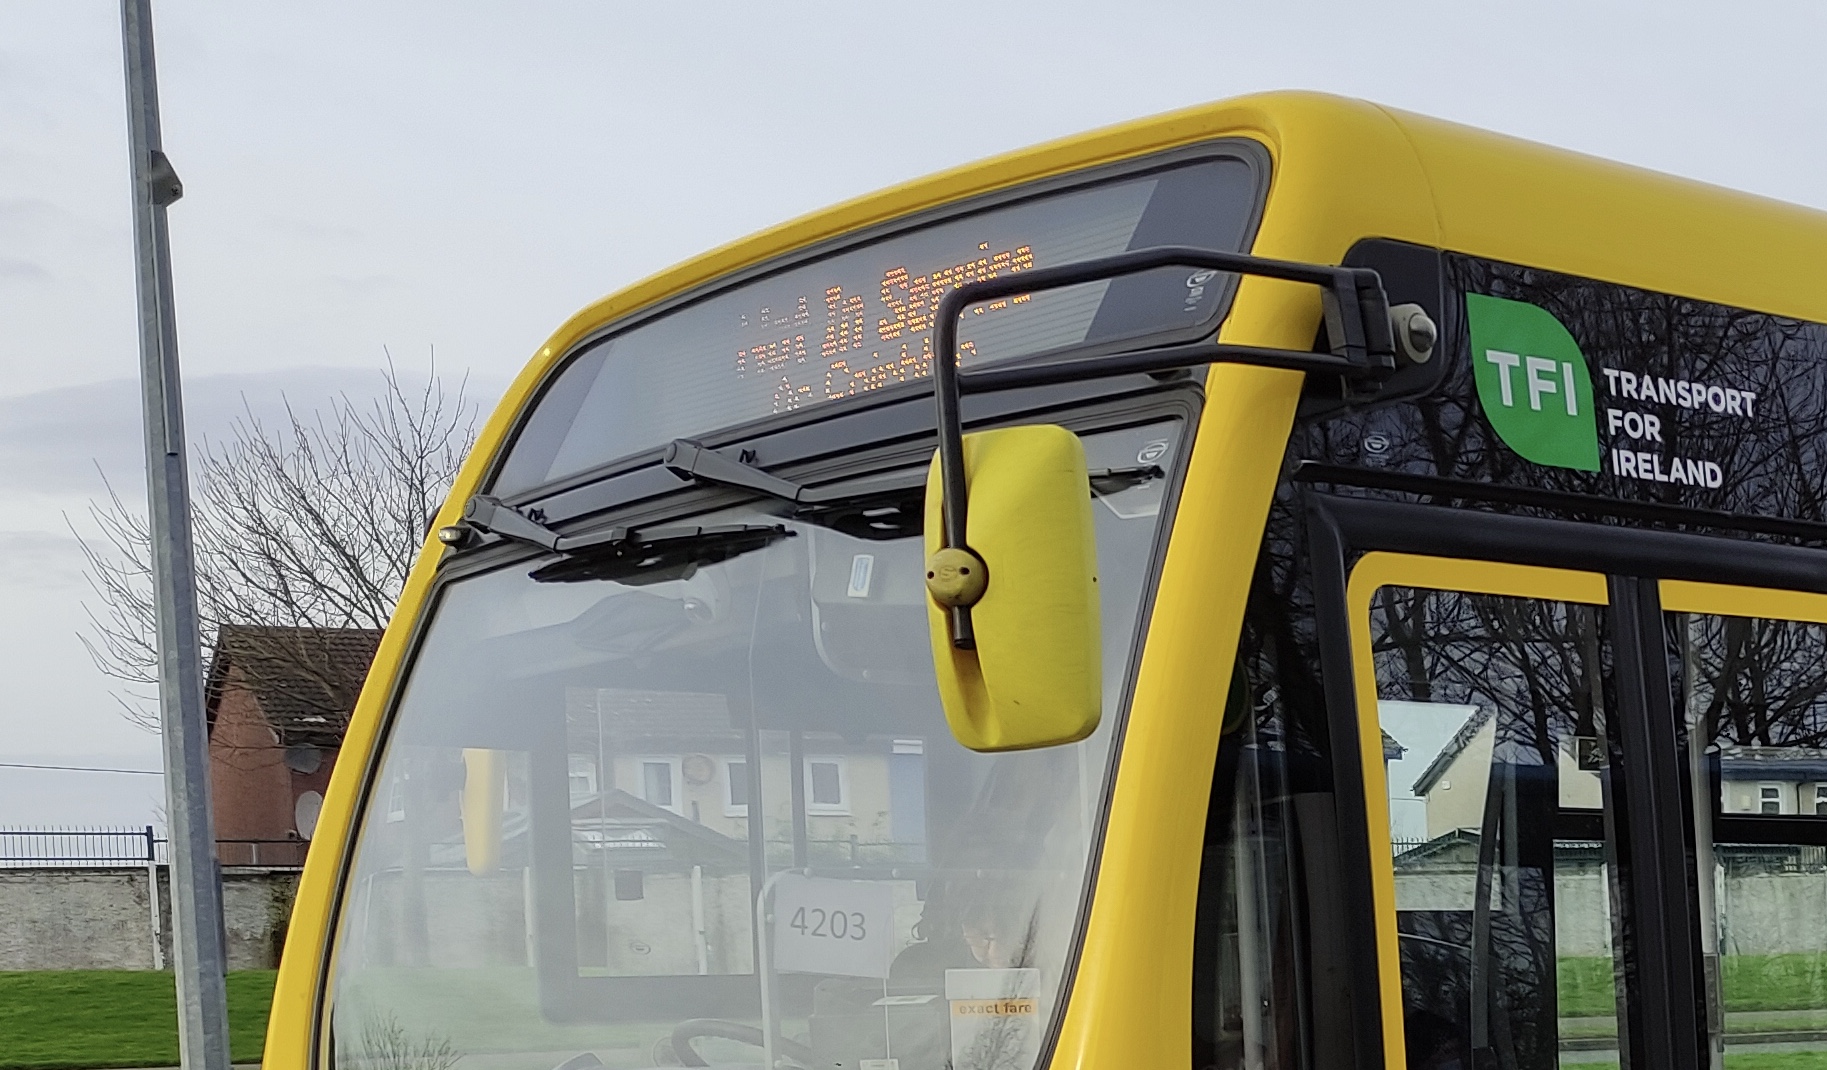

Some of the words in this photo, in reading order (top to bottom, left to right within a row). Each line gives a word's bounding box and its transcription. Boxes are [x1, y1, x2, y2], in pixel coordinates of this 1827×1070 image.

[1485, 348, 1579, 417] TFI
[1602, 367, 1757, 418] TRANSPORT
[1606, 407, 1663, 443] FOR
[1611, 447, 1723, 489] IRELAND
[789, 906, 867, 941] 4203
[959, 1003, 1000, 1014] exact
[1003, 1002, 1032, 1014] fare
